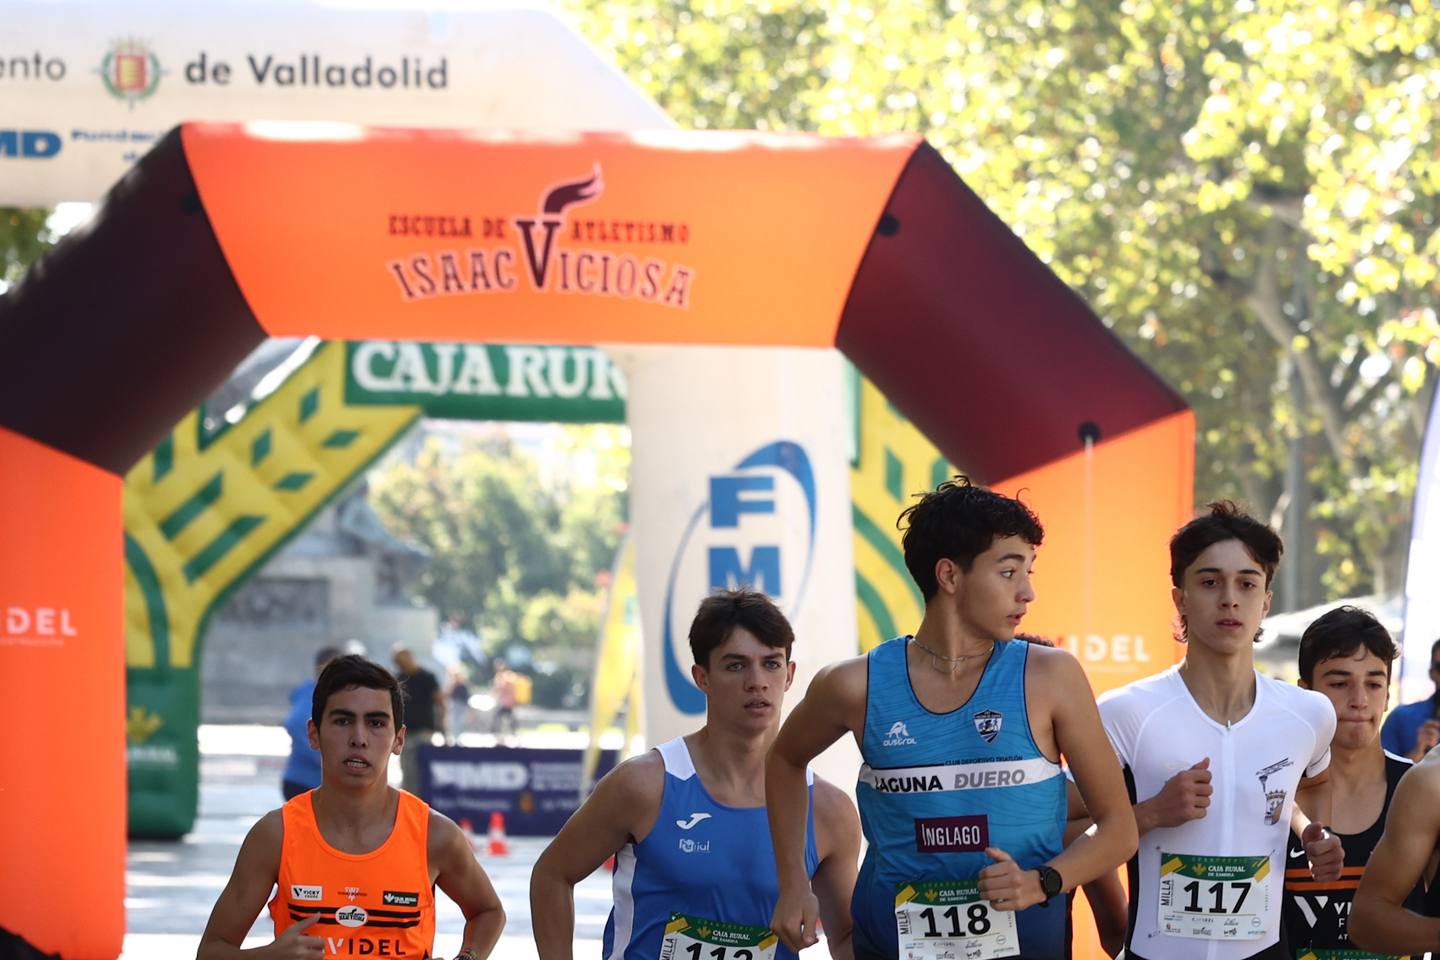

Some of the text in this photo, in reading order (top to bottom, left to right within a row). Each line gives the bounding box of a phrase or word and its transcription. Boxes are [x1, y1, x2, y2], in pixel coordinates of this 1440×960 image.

[185, 52, 231, 85] de
[247, 54, 449, 89] Valladolid
[389, 215, 690, 244] ESCUELA DE ATLETISMO
[392, 251, 515, 300] ISAAC
[351, 338, 500, 396] CAJA
[1066, 633, 1152, 662] IDEL
[921, 823, 981, 847] INGLAGO
[1160, 880, 1171, 906] MILLA
[1184, 881, 1251, 914] 117
[896, 909, 909, 935] MILLA
[920, 903, 991, 937] 118
[328, 936, 406, 956] VIDEL
